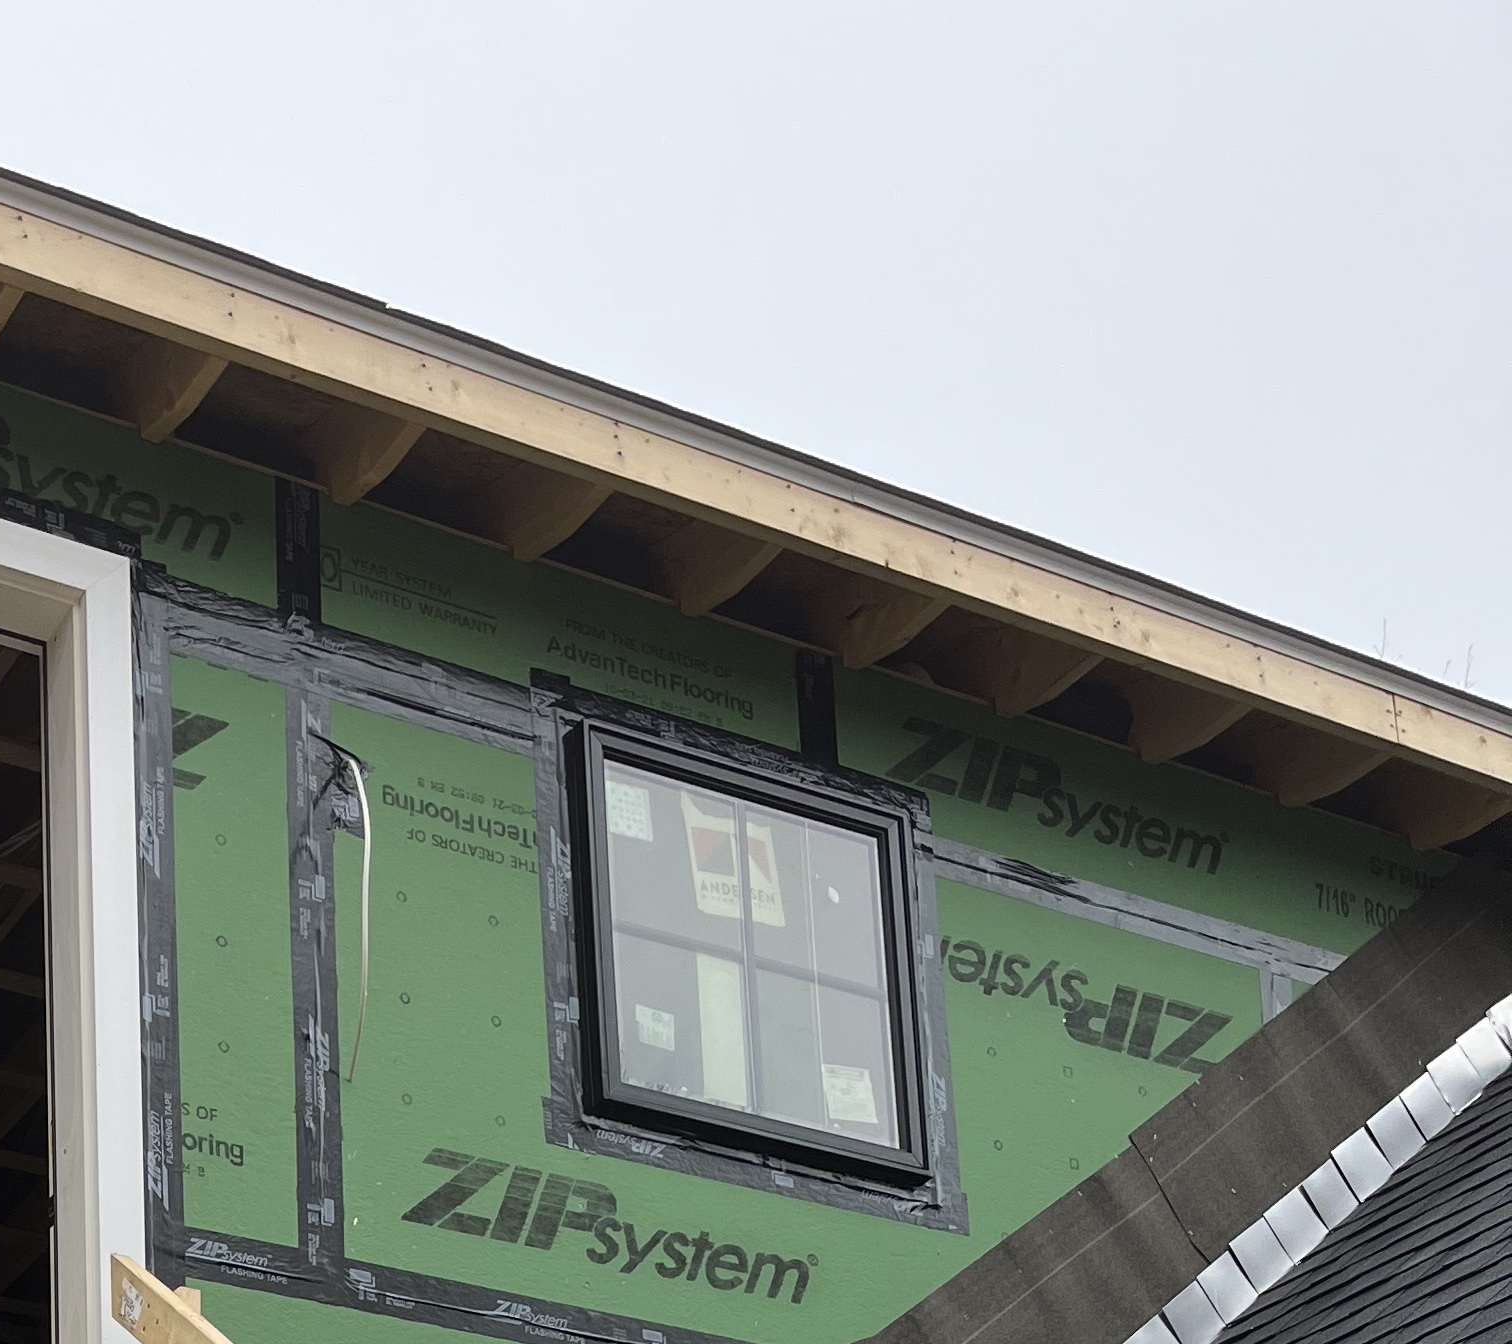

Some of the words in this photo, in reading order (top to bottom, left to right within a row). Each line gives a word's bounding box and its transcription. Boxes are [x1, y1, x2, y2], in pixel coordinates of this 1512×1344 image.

[352, 580, 412, 611] LIMITED
[419, 603, 498, 638] WARRANTY
[886, 715, 1225, 875] ZIPsystem
[406, 826, 427, 844] OF
[431, 833, 506, 866] CREATORS
[510, 854, 538, 876] THE
[699, 880, 776, 906] ANDESEN
[1363, 896, 1402, 929] ROO
[939, 934, 1234, 1076] ZIPsyste
[163, 1091, 173, 1117] TAPE
[196, 1104, 219, 1122] OF
[148, 1109, 162, 1198] ZIPsystem
[163, 1118, 174, 1166] FLASHING
[182, 1132, 245, 1168] oring
[400, 1146, 812, 1305] ZIPsystem
[187, 1236, 269, 1268] ZIPsystem
[219, 1264, 264, 1282] FLASHING
[265, 1273, 289, 1286] TAPE
[493, 1299, 569, 1330] ZIPsystem
[523, 1325, 565, 1342] FLASHING
